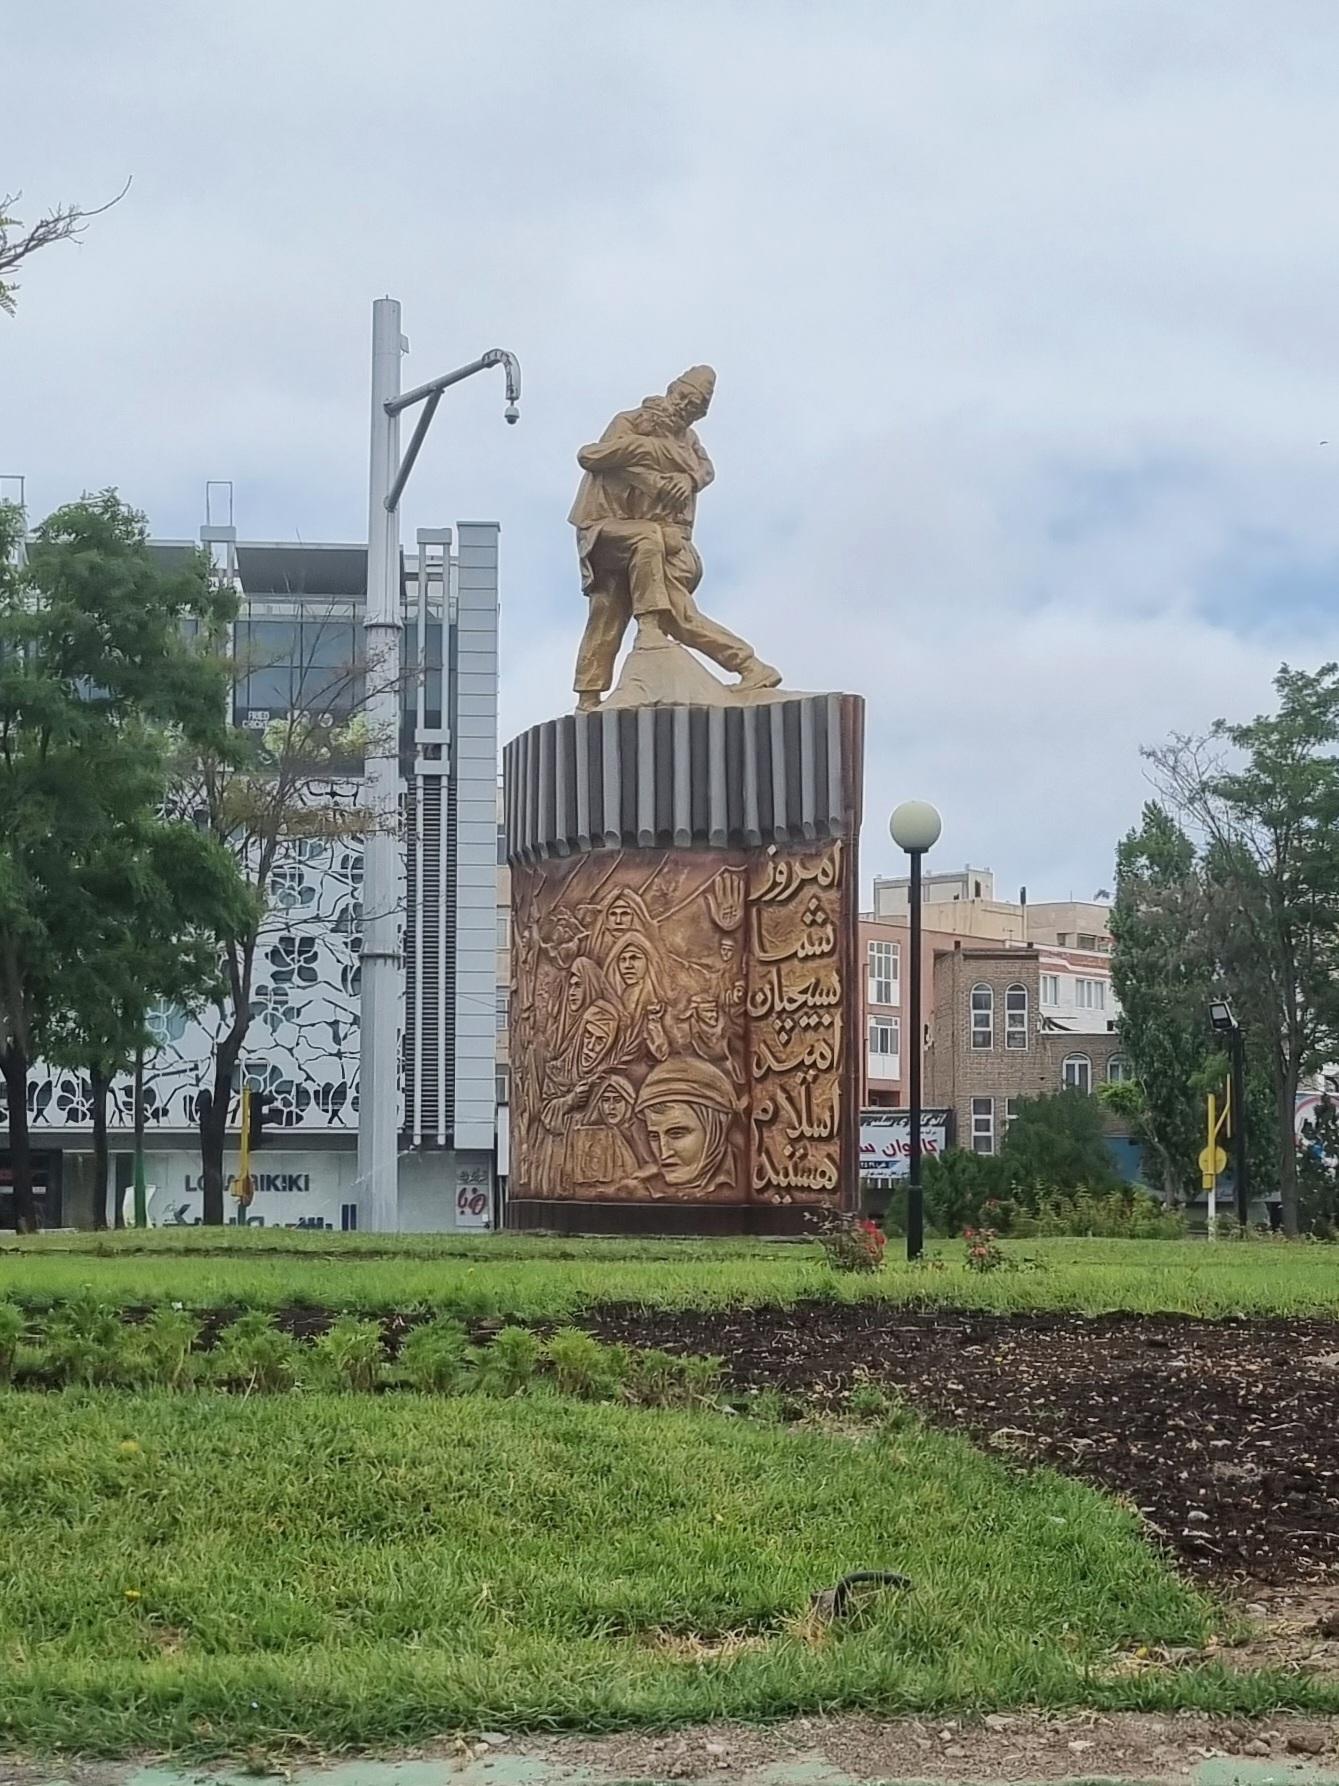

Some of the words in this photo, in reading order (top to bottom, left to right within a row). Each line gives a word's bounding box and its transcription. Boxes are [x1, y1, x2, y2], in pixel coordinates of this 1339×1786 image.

[747, 839, 842, 901] امروز
[753, 897, 834, 962] شما
[747, 965, 842, 1044] بسیجیان
[753, 1008, 842, 1082] امید
[752, 1079, 841, 1160] اسلام
[882, 1138, 938, 1157] کاوان
[752, 1144, 839, 1204] هستید
